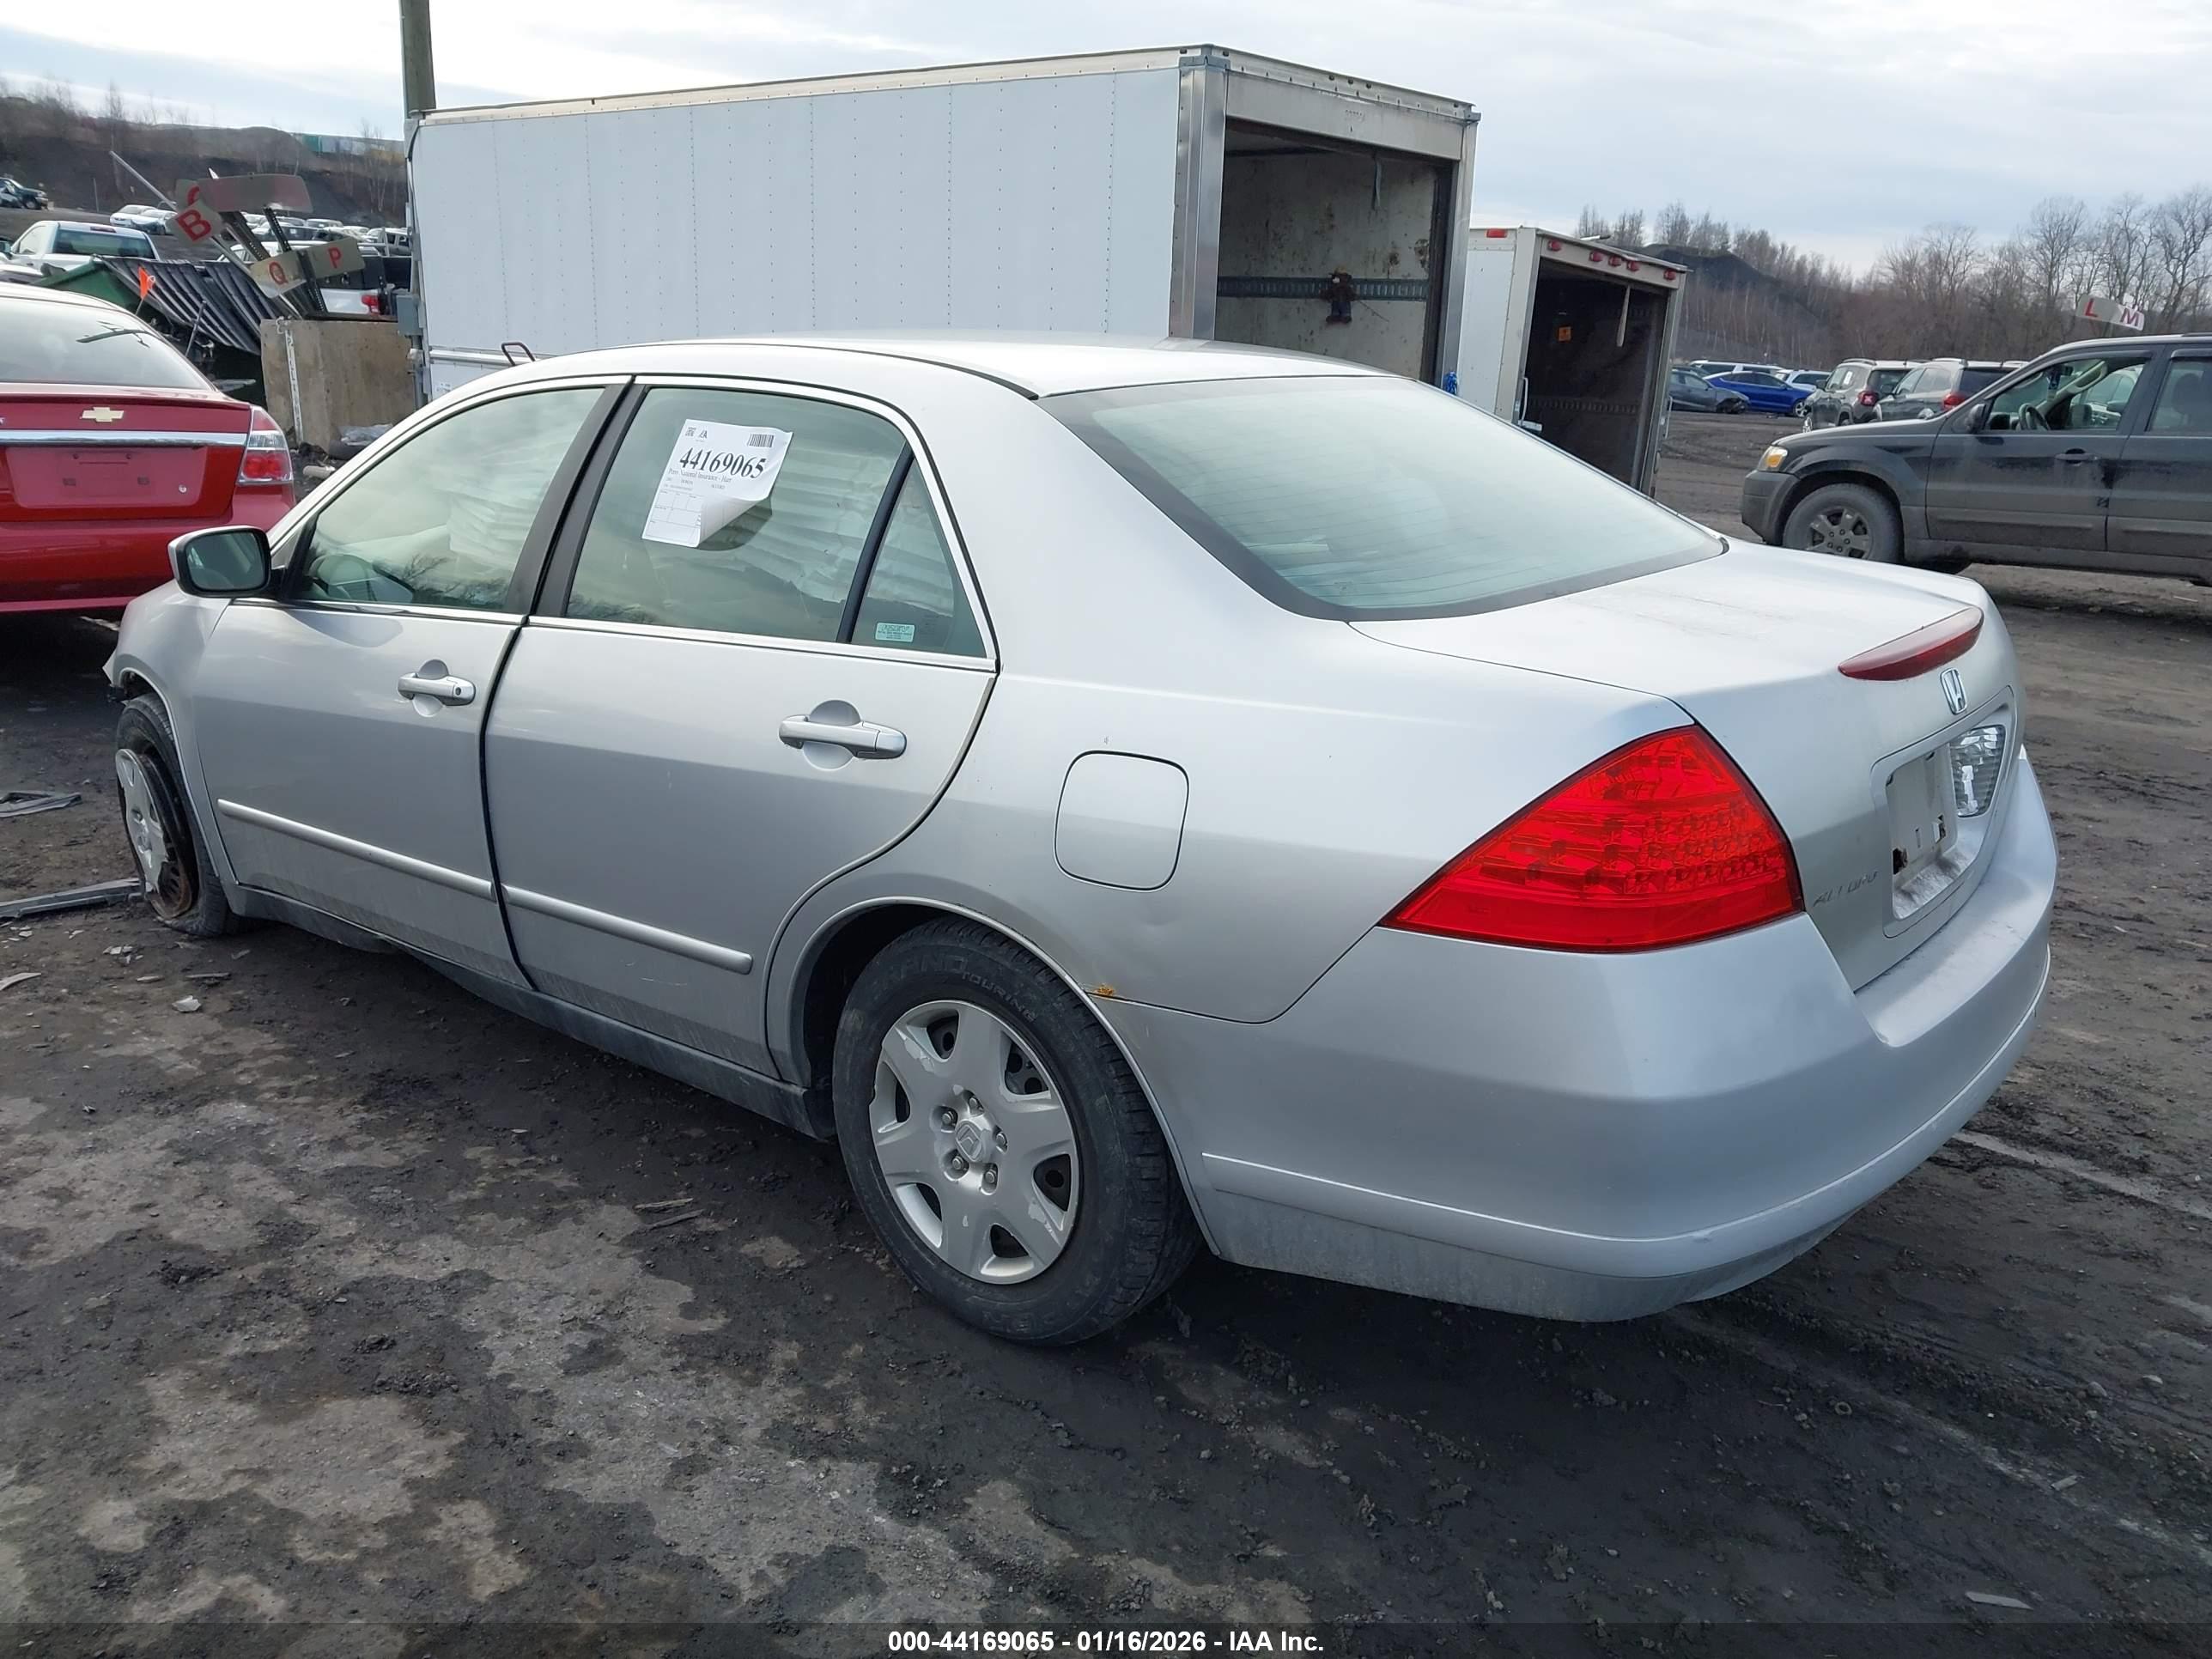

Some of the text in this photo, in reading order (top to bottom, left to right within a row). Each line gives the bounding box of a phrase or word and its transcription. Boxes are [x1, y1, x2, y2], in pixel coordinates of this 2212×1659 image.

[175, 209, 212, 241] B
[328, 246, 342, 269] P
[268, 261, 289, 285] Q
[2084, 297, 2099, 318] L
[2120, 307, 2140, 326] M
[679, 447, 767, 479] 44169065
[962, 971, 1038, 1024] TOURING
